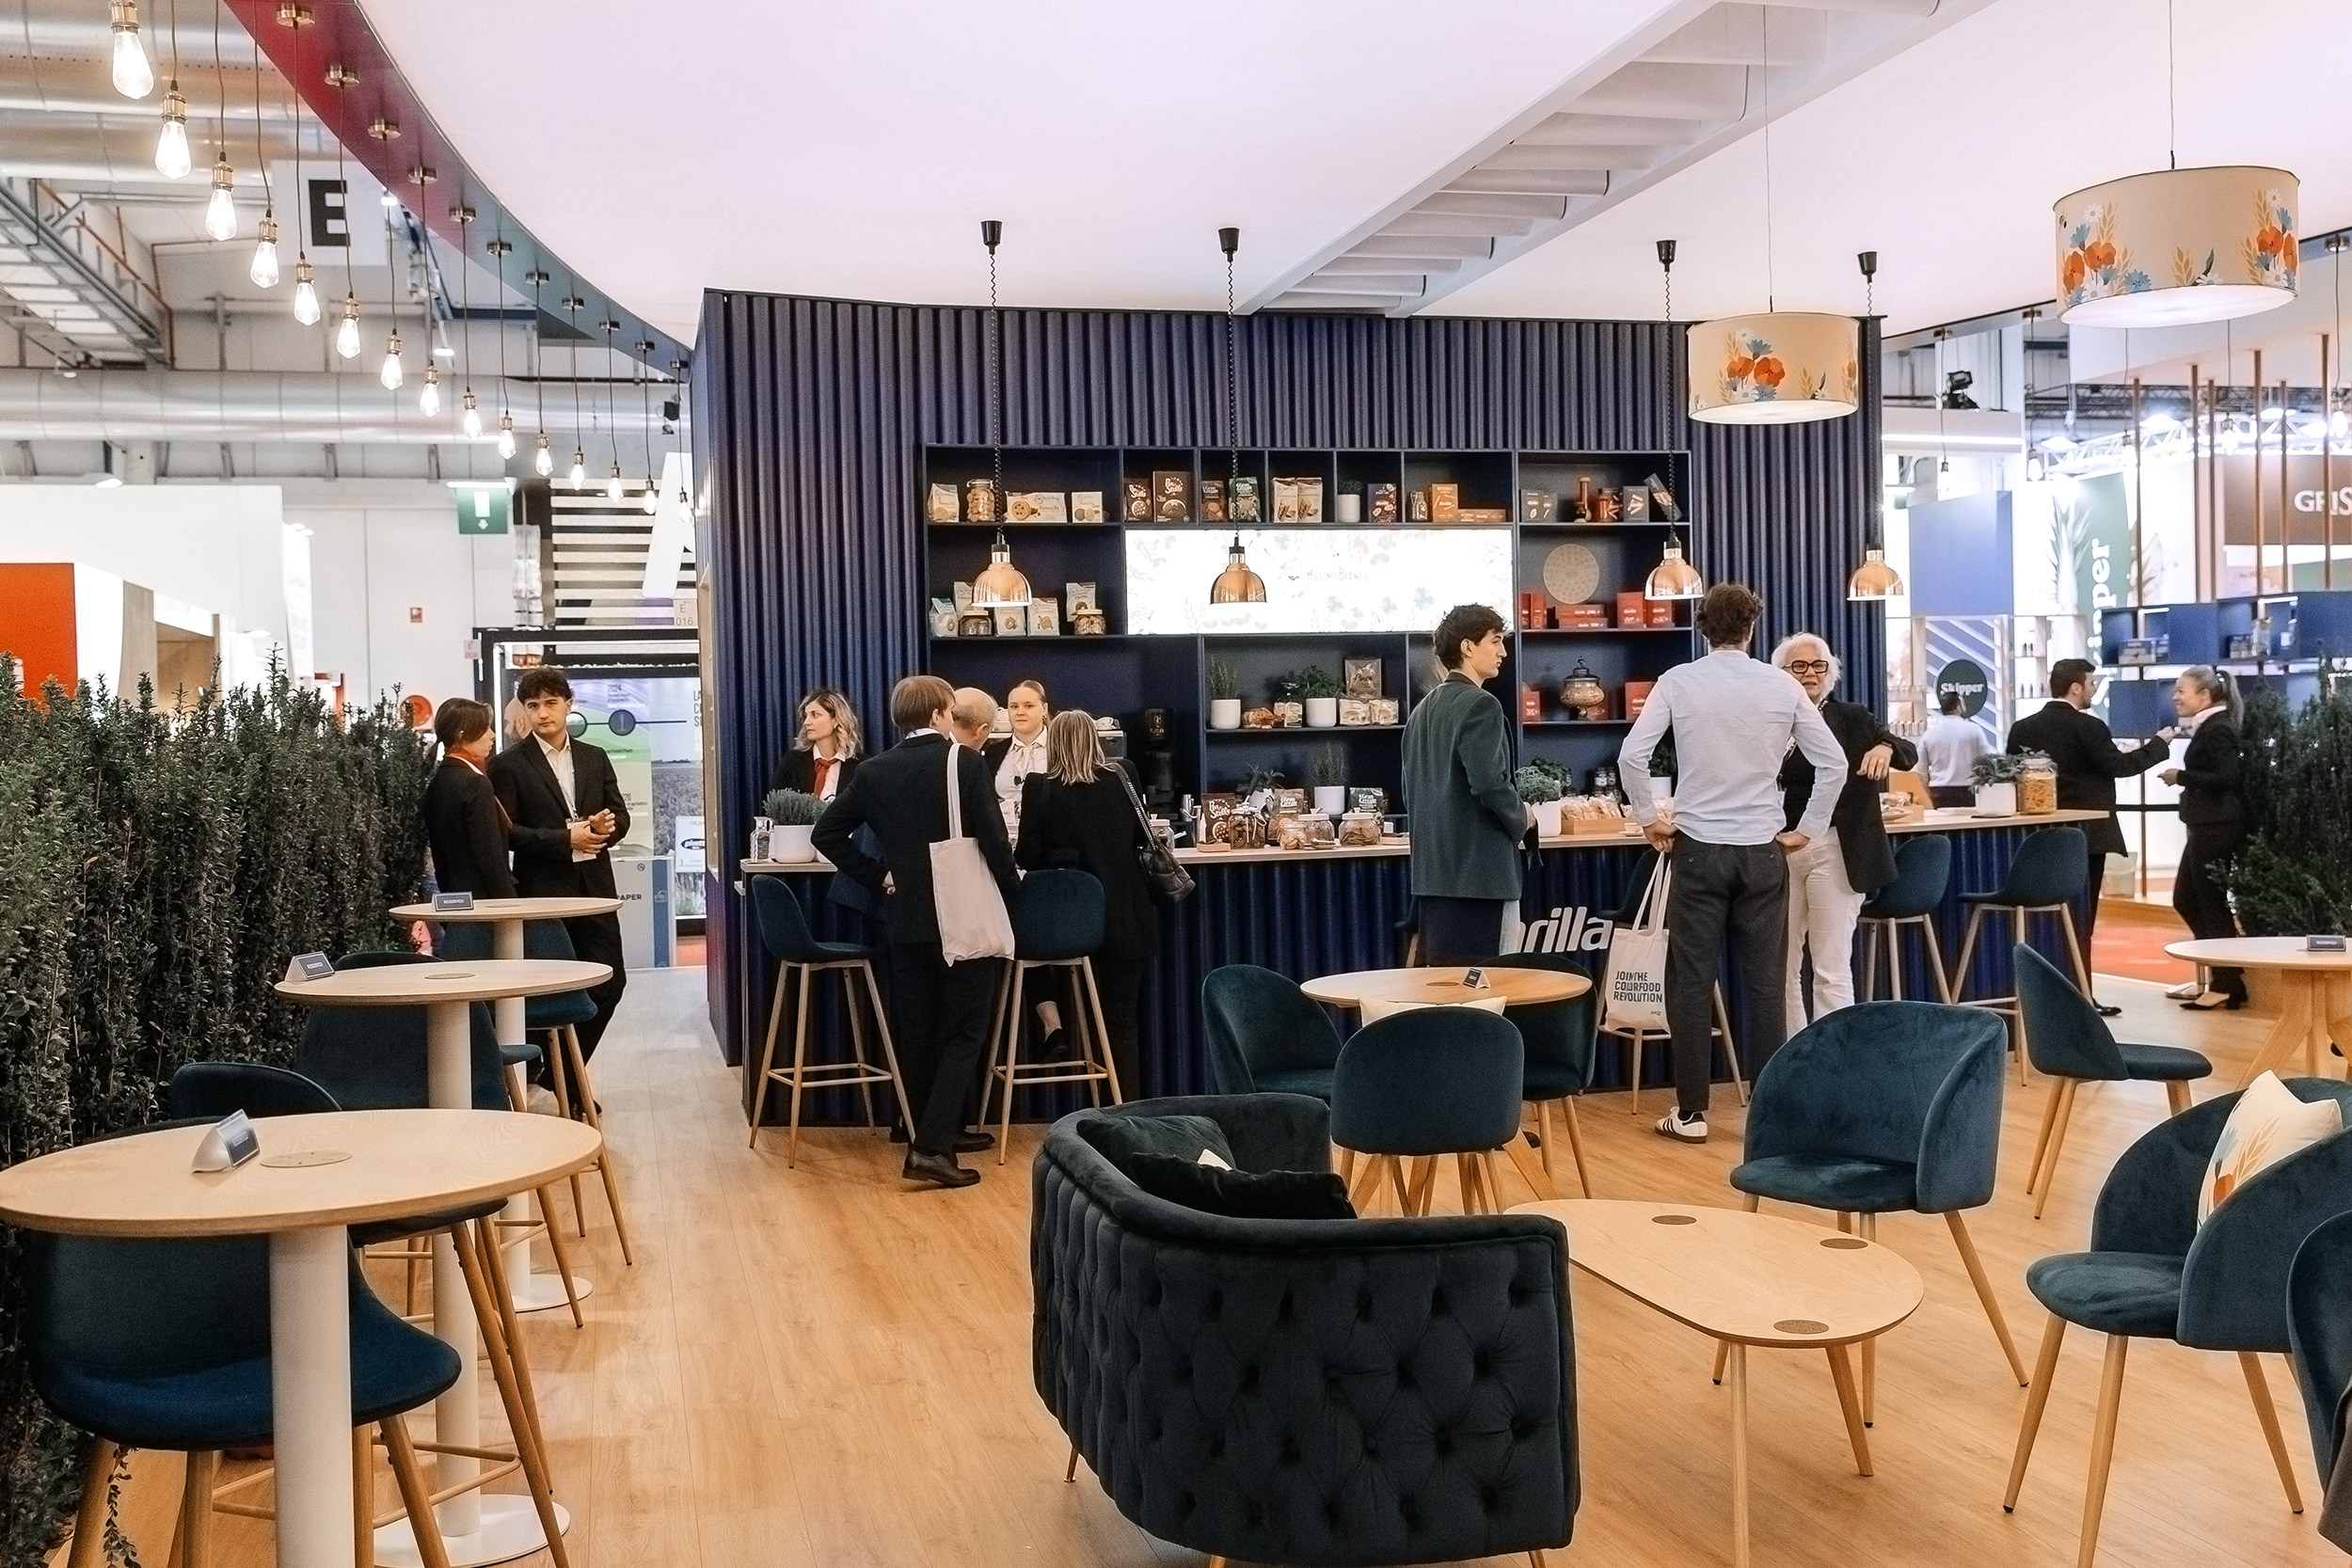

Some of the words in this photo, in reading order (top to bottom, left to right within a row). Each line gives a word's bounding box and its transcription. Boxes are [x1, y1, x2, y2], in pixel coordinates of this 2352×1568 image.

[309, 179, 350, 246] E
[1940, 682, 1984, 696] Skipper
[1517, 906, 1613, 954] rilla
